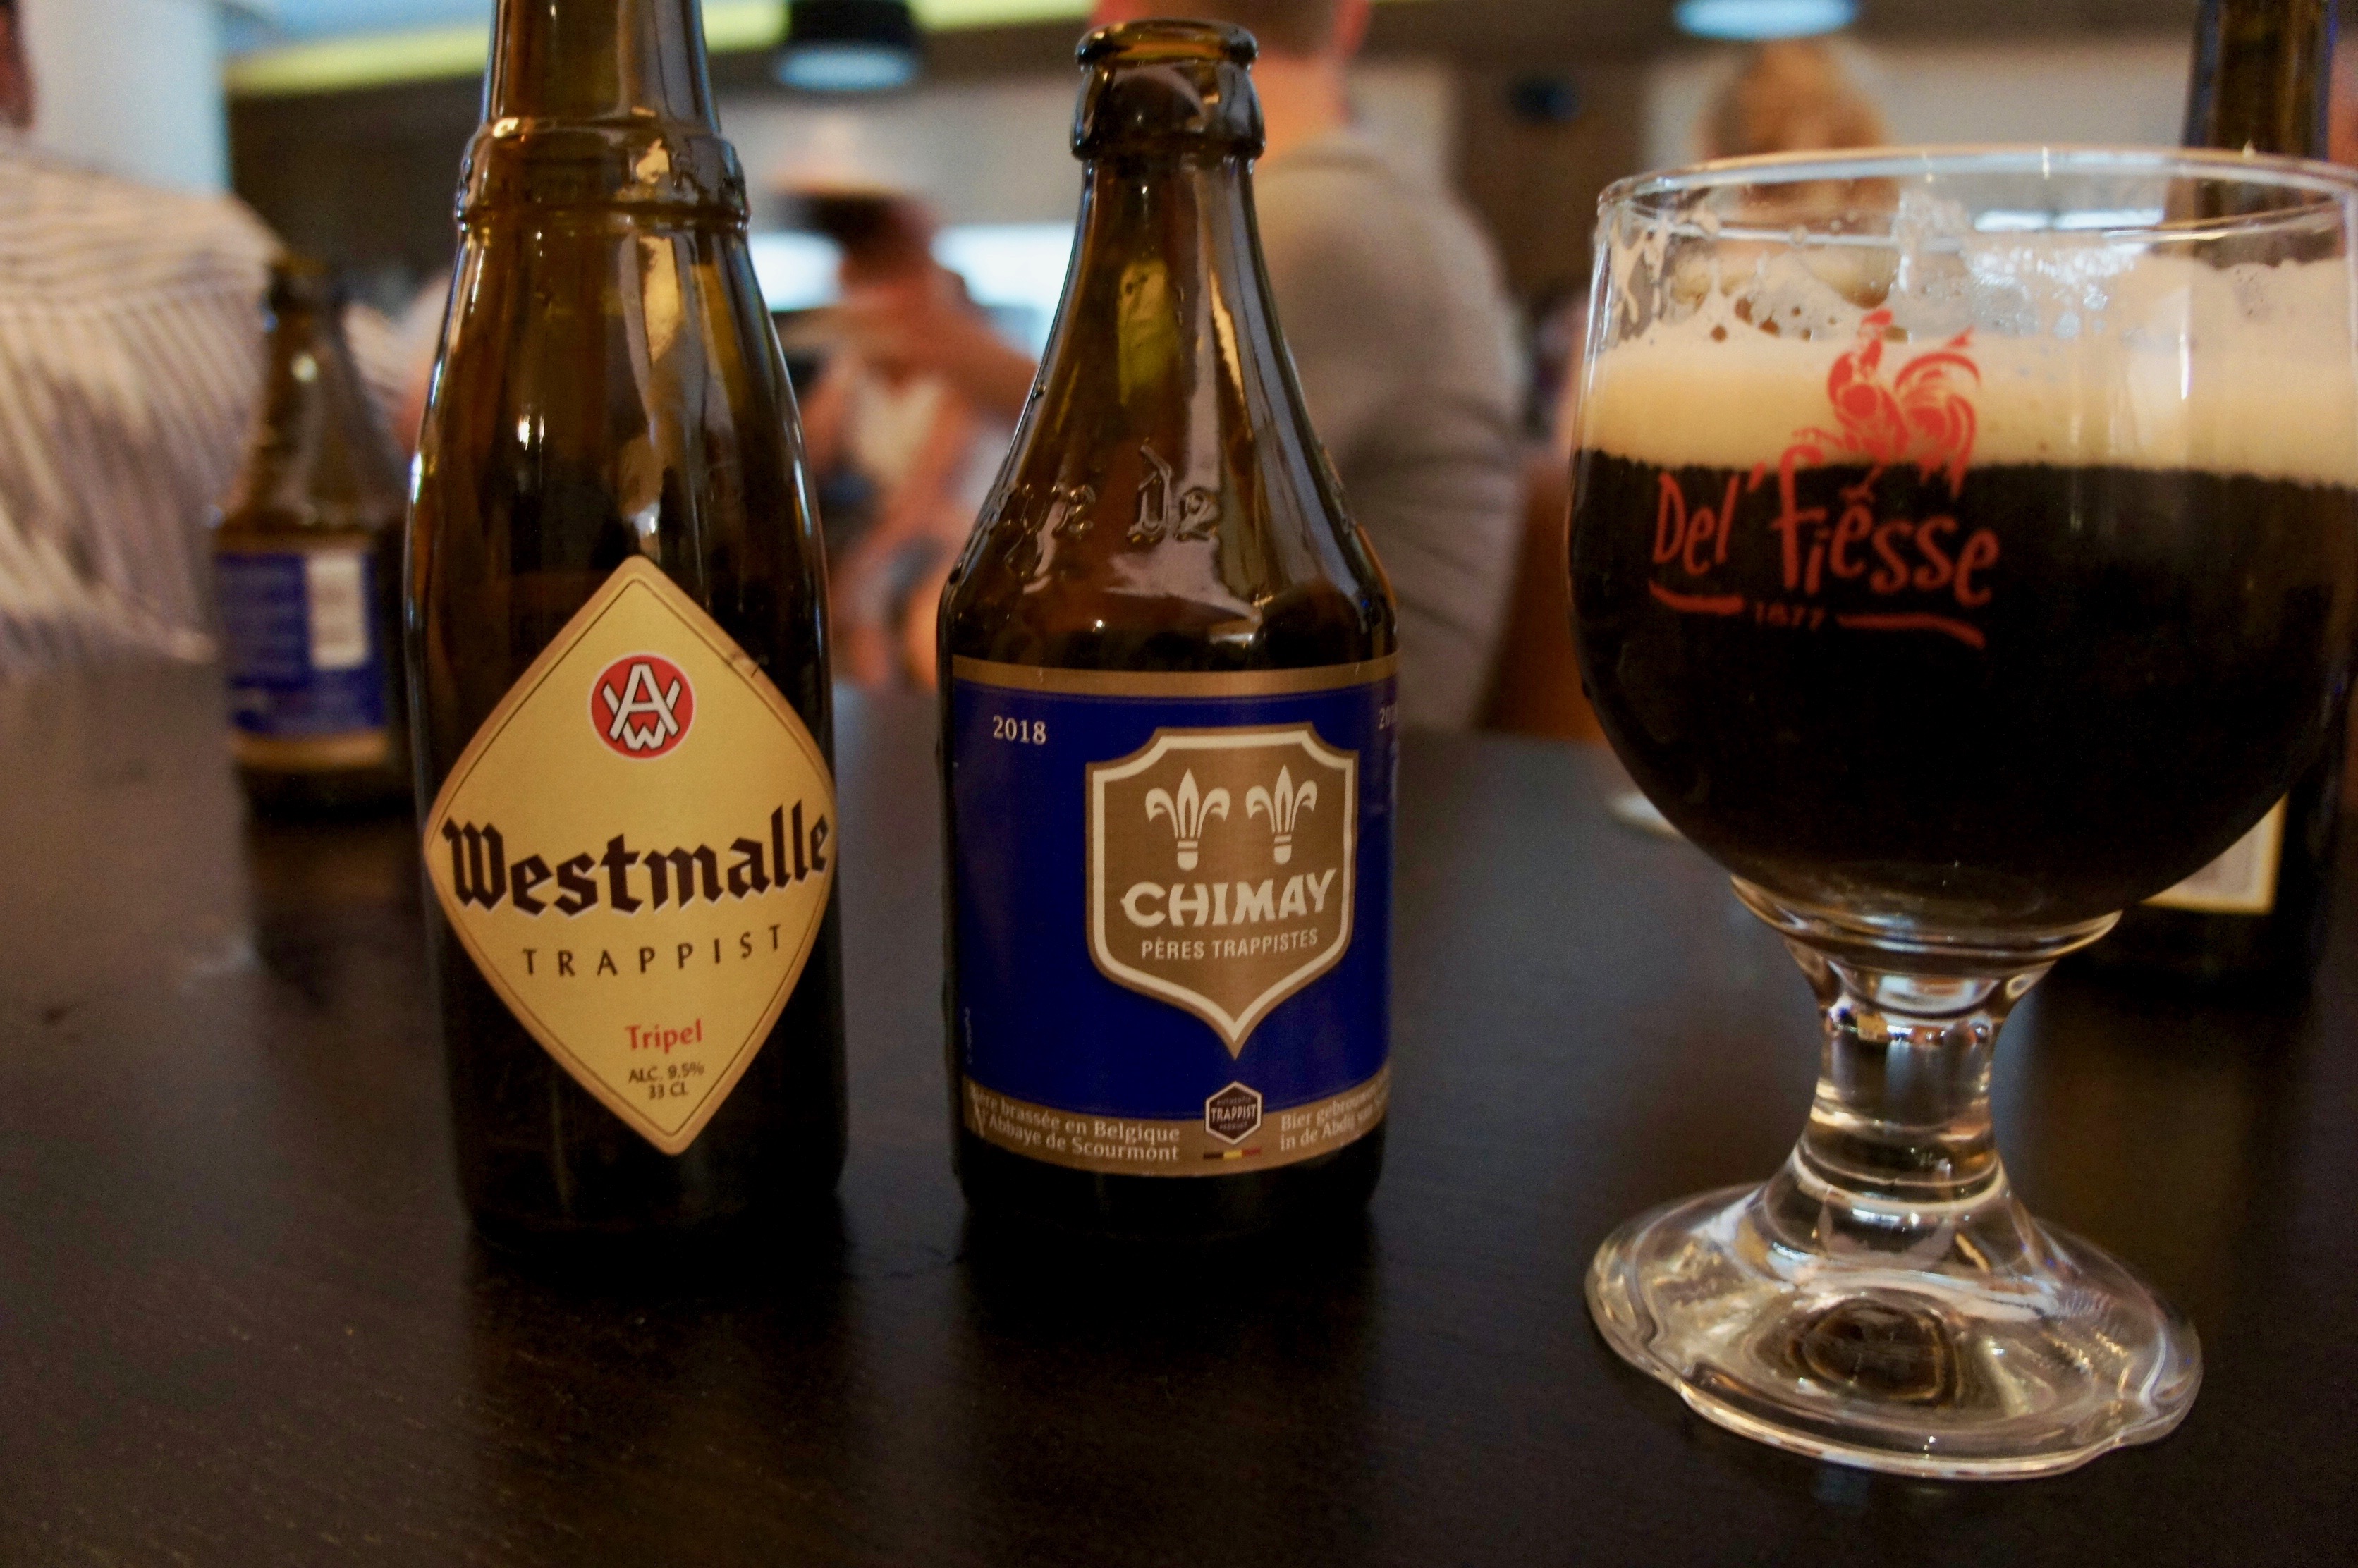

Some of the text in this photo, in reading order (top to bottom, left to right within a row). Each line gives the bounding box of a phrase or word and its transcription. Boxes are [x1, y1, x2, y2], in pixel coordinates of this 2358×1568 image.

[992, 714, 1047, 745] 2018
[442, 799, 829, 917] Westmalle
[1120, 867, 1338, 929] CHIMAY
[522, 923, 783, 978] TRAPPIST
[1141, 927, 1318, 960] PÈRES TRAPPISTES
[624, 1017, 703, 1055] Tripel
[1001, 1097, 1060, 1128] brassée
[1065, 1119, 1087, 1136] en
[1094, 1119, 1180, 1146] Belgique
[1210, 1103, 1257, 1123] TRAPPIST
[1281, 1112, 1312, 1132] Bier
[1045, 1132, 1066, 1152] de
[1071, 1136, 1180, 1163] Scourmont
[1281, 1134, 1296, 1151] in
[1300, 1127, 1319, 1147] de
